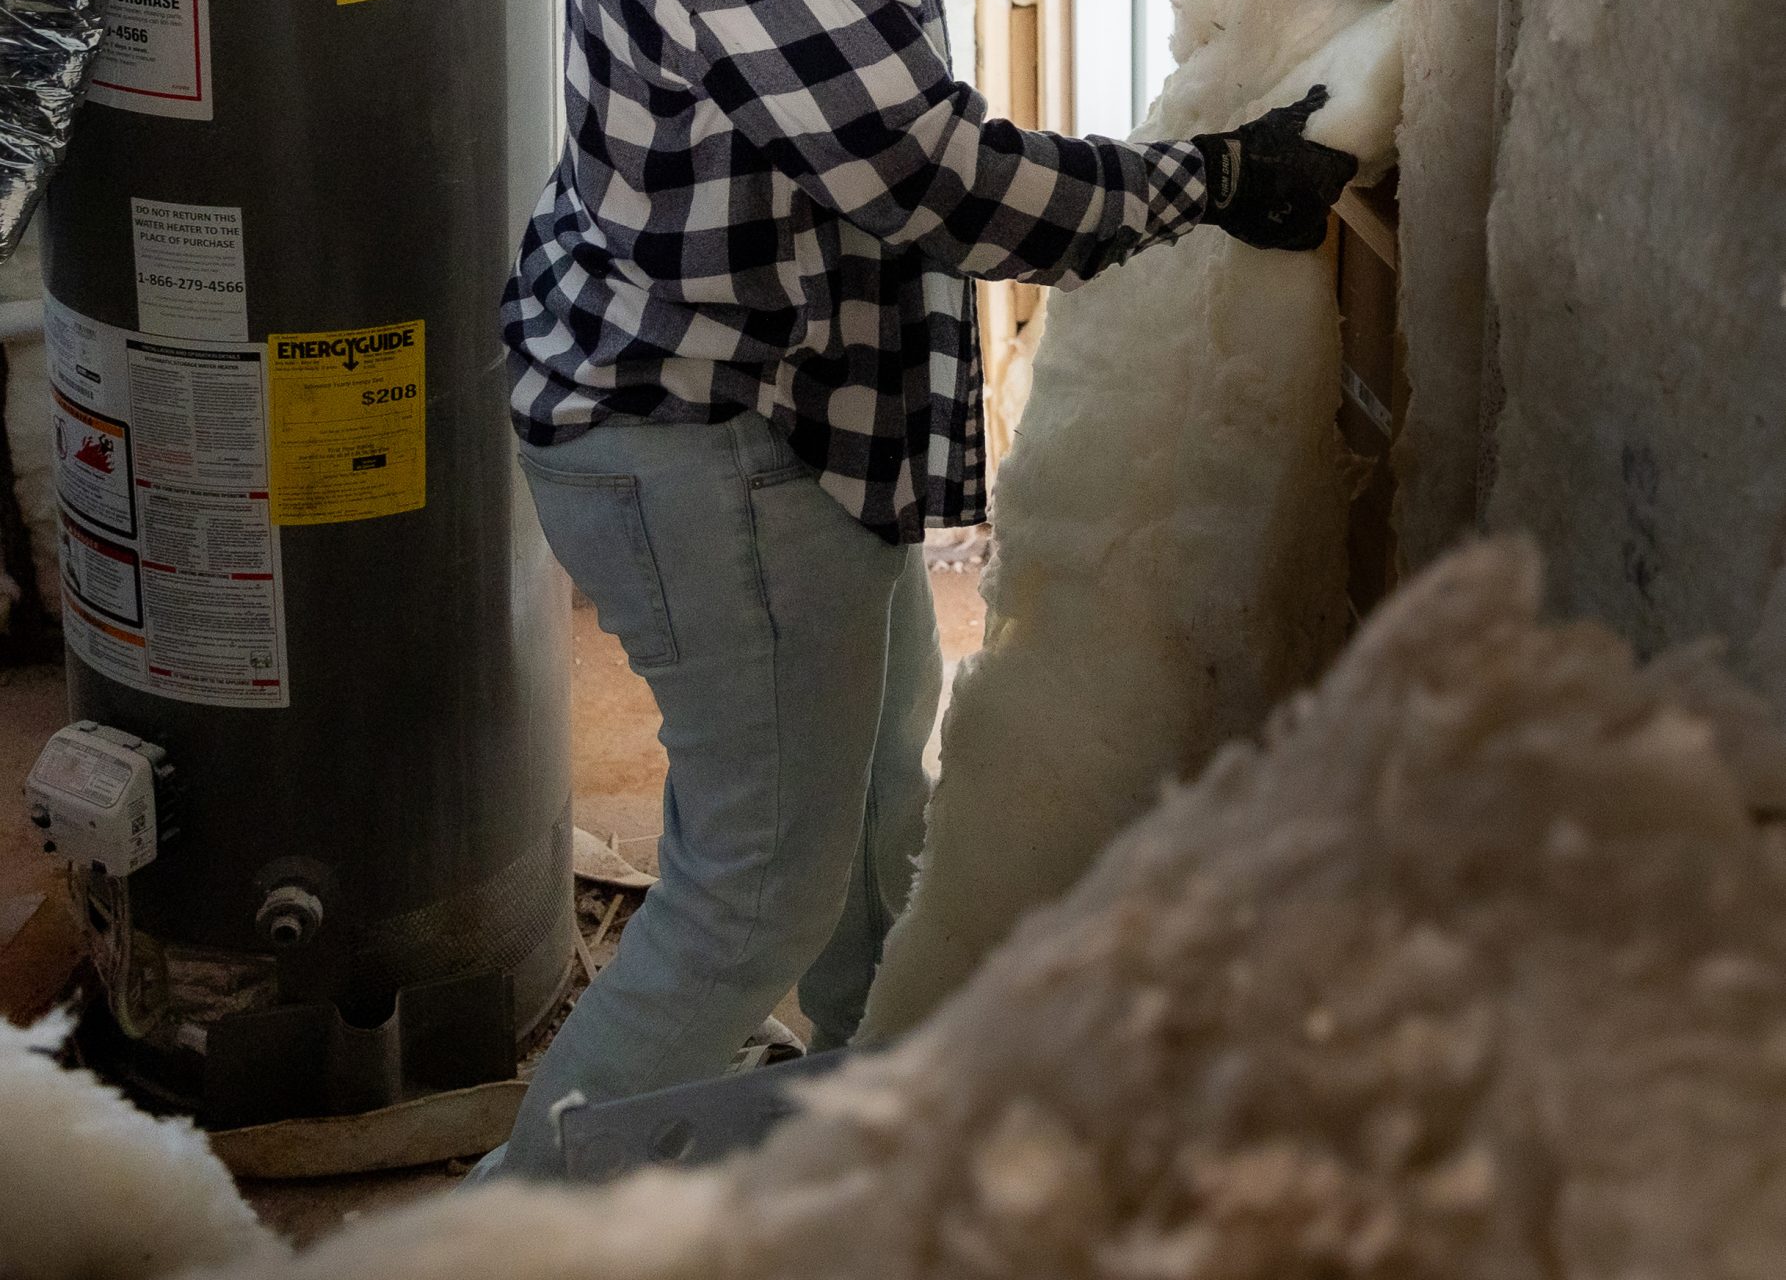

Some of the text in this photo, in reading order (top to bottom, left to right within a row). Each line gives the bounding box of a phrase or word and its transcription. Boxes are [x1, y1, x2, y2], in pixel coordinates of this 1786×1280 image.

[135, 206, 236, 222] DO NOT RETURN THIS
[135, 219, 240, 236] WATER HEATER TO THE
[140, 232, 235, 249] PLACE OF PURCHASE
[138, 272, 244, 293] 1-866-279-4566
[278, 329, 414, 361] ENERGYGUIDE
[361, 383, 417, 406] $208
